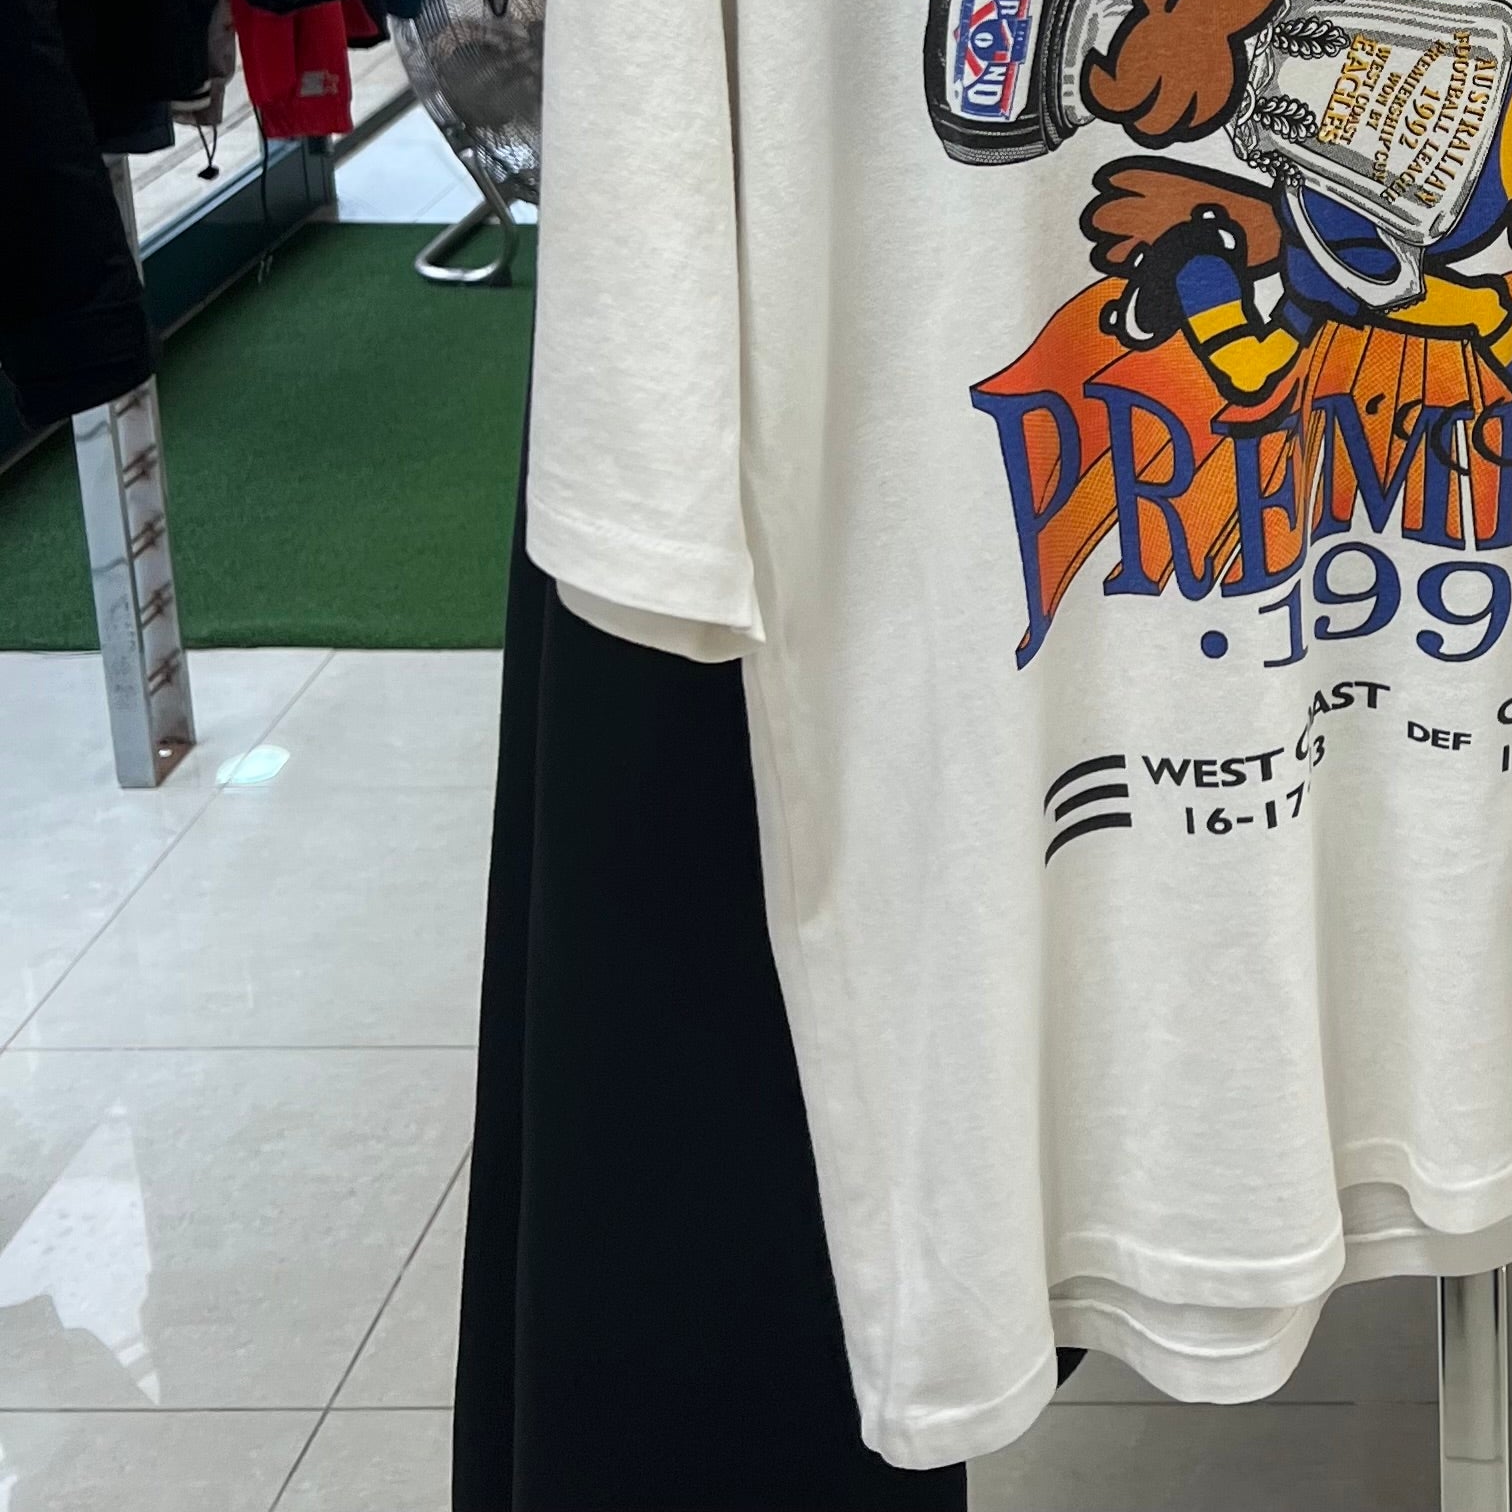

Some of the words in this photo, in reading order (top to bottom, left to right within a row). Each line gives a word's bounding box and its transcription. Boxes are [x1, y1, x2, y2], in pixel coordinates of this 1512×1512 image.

[1315, 33, 1379, 146] EAGLES
[1362, 44, 1393, 92] WEST
[1375, 71, 1404, 107] WON
[1378, 39, 1449, 152] PREMIERSHIP
[1432, 30, 1473, 134] FOOTBALL
[1338, 92, 1371, 146] COAST
[1365, 108, 1384, 132] BY
[1399, 85, 1442, 150] 1992
[1414, 56, 1498, 209] AUSTRALIAN
[1143, 747, 1285, 788] WEST
[1407, 720, 1473, 751] DEF
